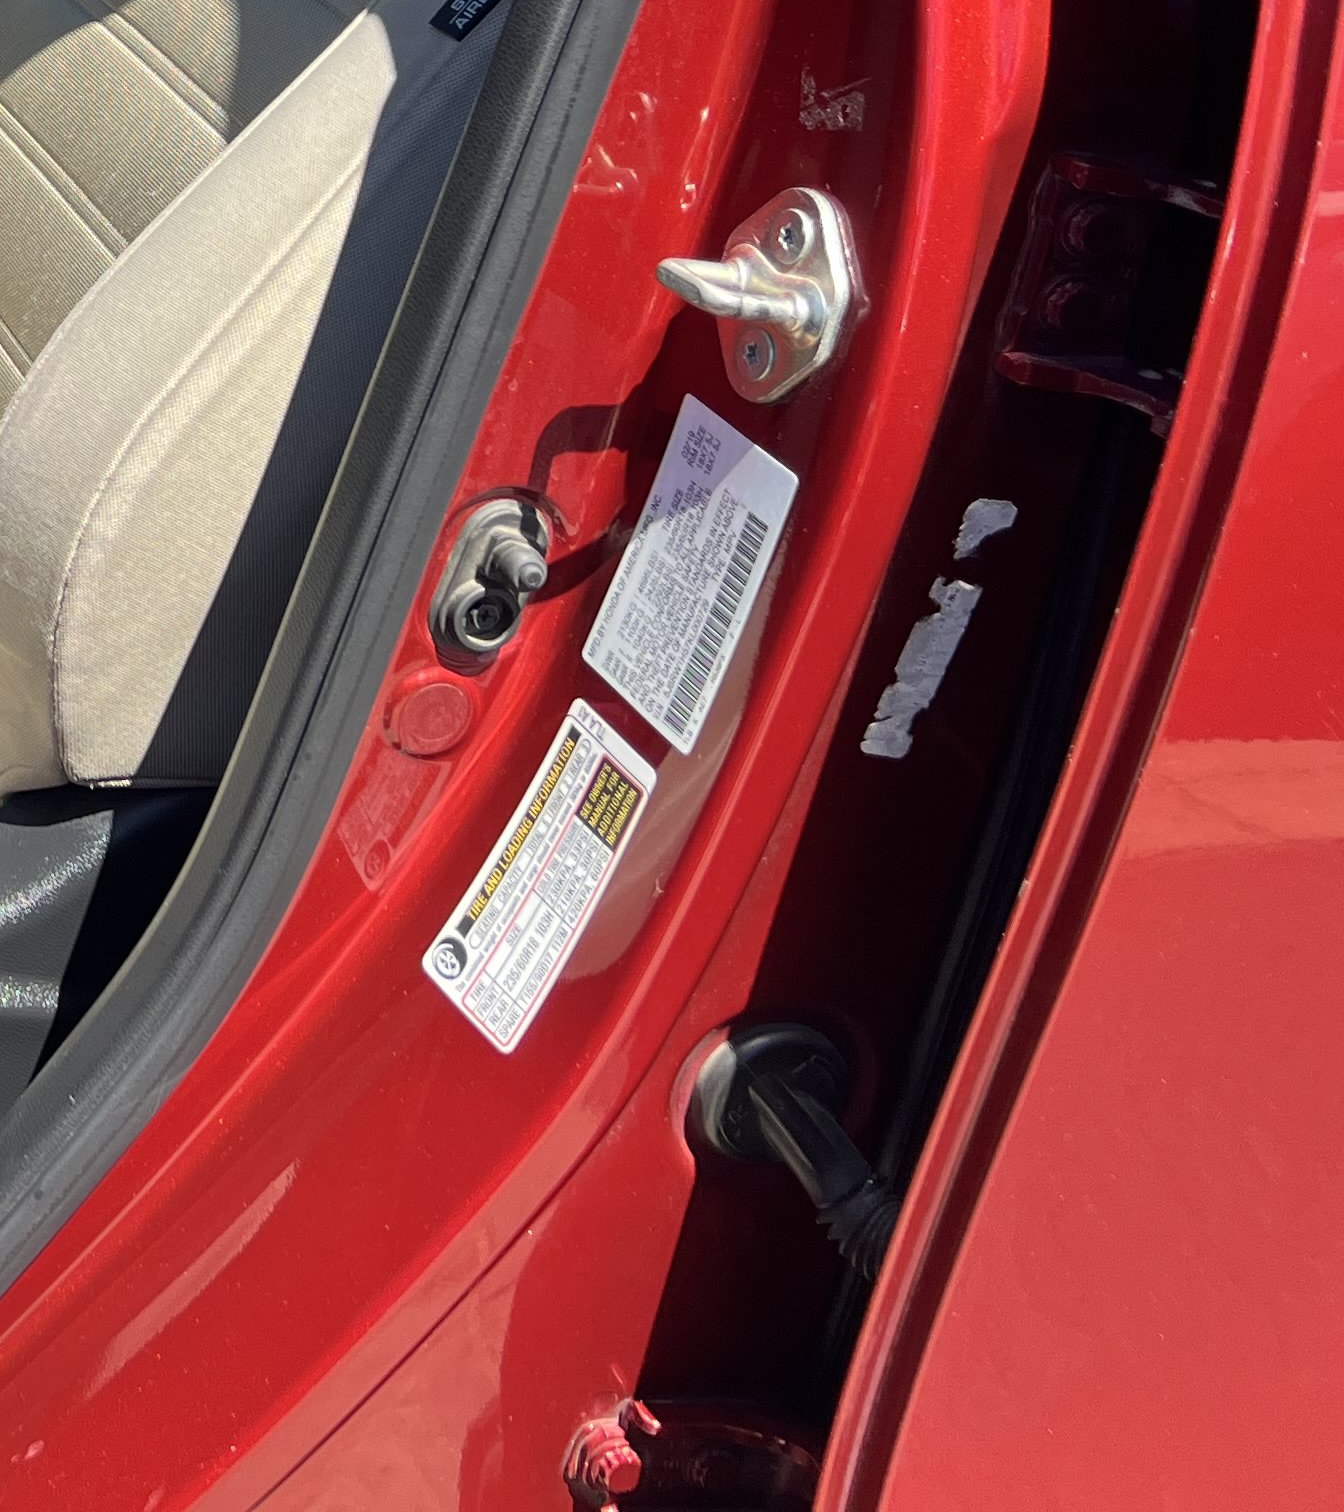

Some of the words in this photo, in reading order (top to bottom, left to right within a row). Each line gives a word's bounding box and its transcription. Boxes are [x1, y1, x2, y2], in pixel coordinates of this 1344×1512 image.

[686, 446, 699, 468] RIM
[692, 423, 707, 449] SIZE
[661, 508, 675, 531] TIRE
[669, 485, 684, 511] SIZE
[711, 487, 732, 526] EFFECT
[707, 524, 717, 538] IN
[722, 529, 737, 554] MPV
[602, 588, 621, 625] HONDA
[616, 575, 627, 592] OF
[622, 533, 645, 578] AMERICA
[623, 667, 637, 692] THIS
[632, 628, 654, 671] VEHICLE
[650, 574, 677, 631] CONFORMS
[673, 560, 683, 576] TO
[678, 545, 689, 562] ALL
[684, 486, 713, 546] APPLICABLE
[685, 536, 713, 595] STANDARDS
[630, 655, 653, 701] FEDERAL
[648, 619, 668, 658] MOTOR
[663, 581, 684, 622] VEHICLE
[680, 543, 700, 582] SAFETY
[645, 696, 656, 714] ON
[652, 676, 664, 698] THE
[660, 651, 675, 679] DATE
[671, 637, 681, 653] OF
[677, 567, 711, 639] MANUFACTURE
[705, 529, 726, 568] SHOWN
[720, 496, 739, 531] ABOVE
[659, 592, 690, 656] PREVENTION
[637, 682, 650, 706] AND
[647, 652, 664, 684] THEFT
[578, 800, 593, 820] SEE
[586, 761, 613, 803] OWNER'S
[586, 789, 612, 829] MANUAL
[604, 769, 621, 792] FOR
[595, 778, 630, 837] ADDITIONAL
[604, 786, 640, 847] INFORMATION
[465, 890, 487, 923] TIRE
[481, 865, 503, 897] AND
[497, 814, 533, 870] LOADING
[524, 735, 578, 819] INFORMATION
[474, 903, 499, 941] SEATING
[496, 862, 523, 905] CAPACITY
[566, 751, 584, 775] REAR
[469, 977, 487, 1003] TIRE
[504, 921, 522, 948] SIZE
[555, 819, 580, 859] PRESSURE
[501, 932, 540, 995] 235/60R18
[533, 907, 554, 938] 103H
[476, 983, 499, 1020] FRONT
[487, 995, 509, 1029] REAR
[497, 1004, 521, 1042] SPARE
